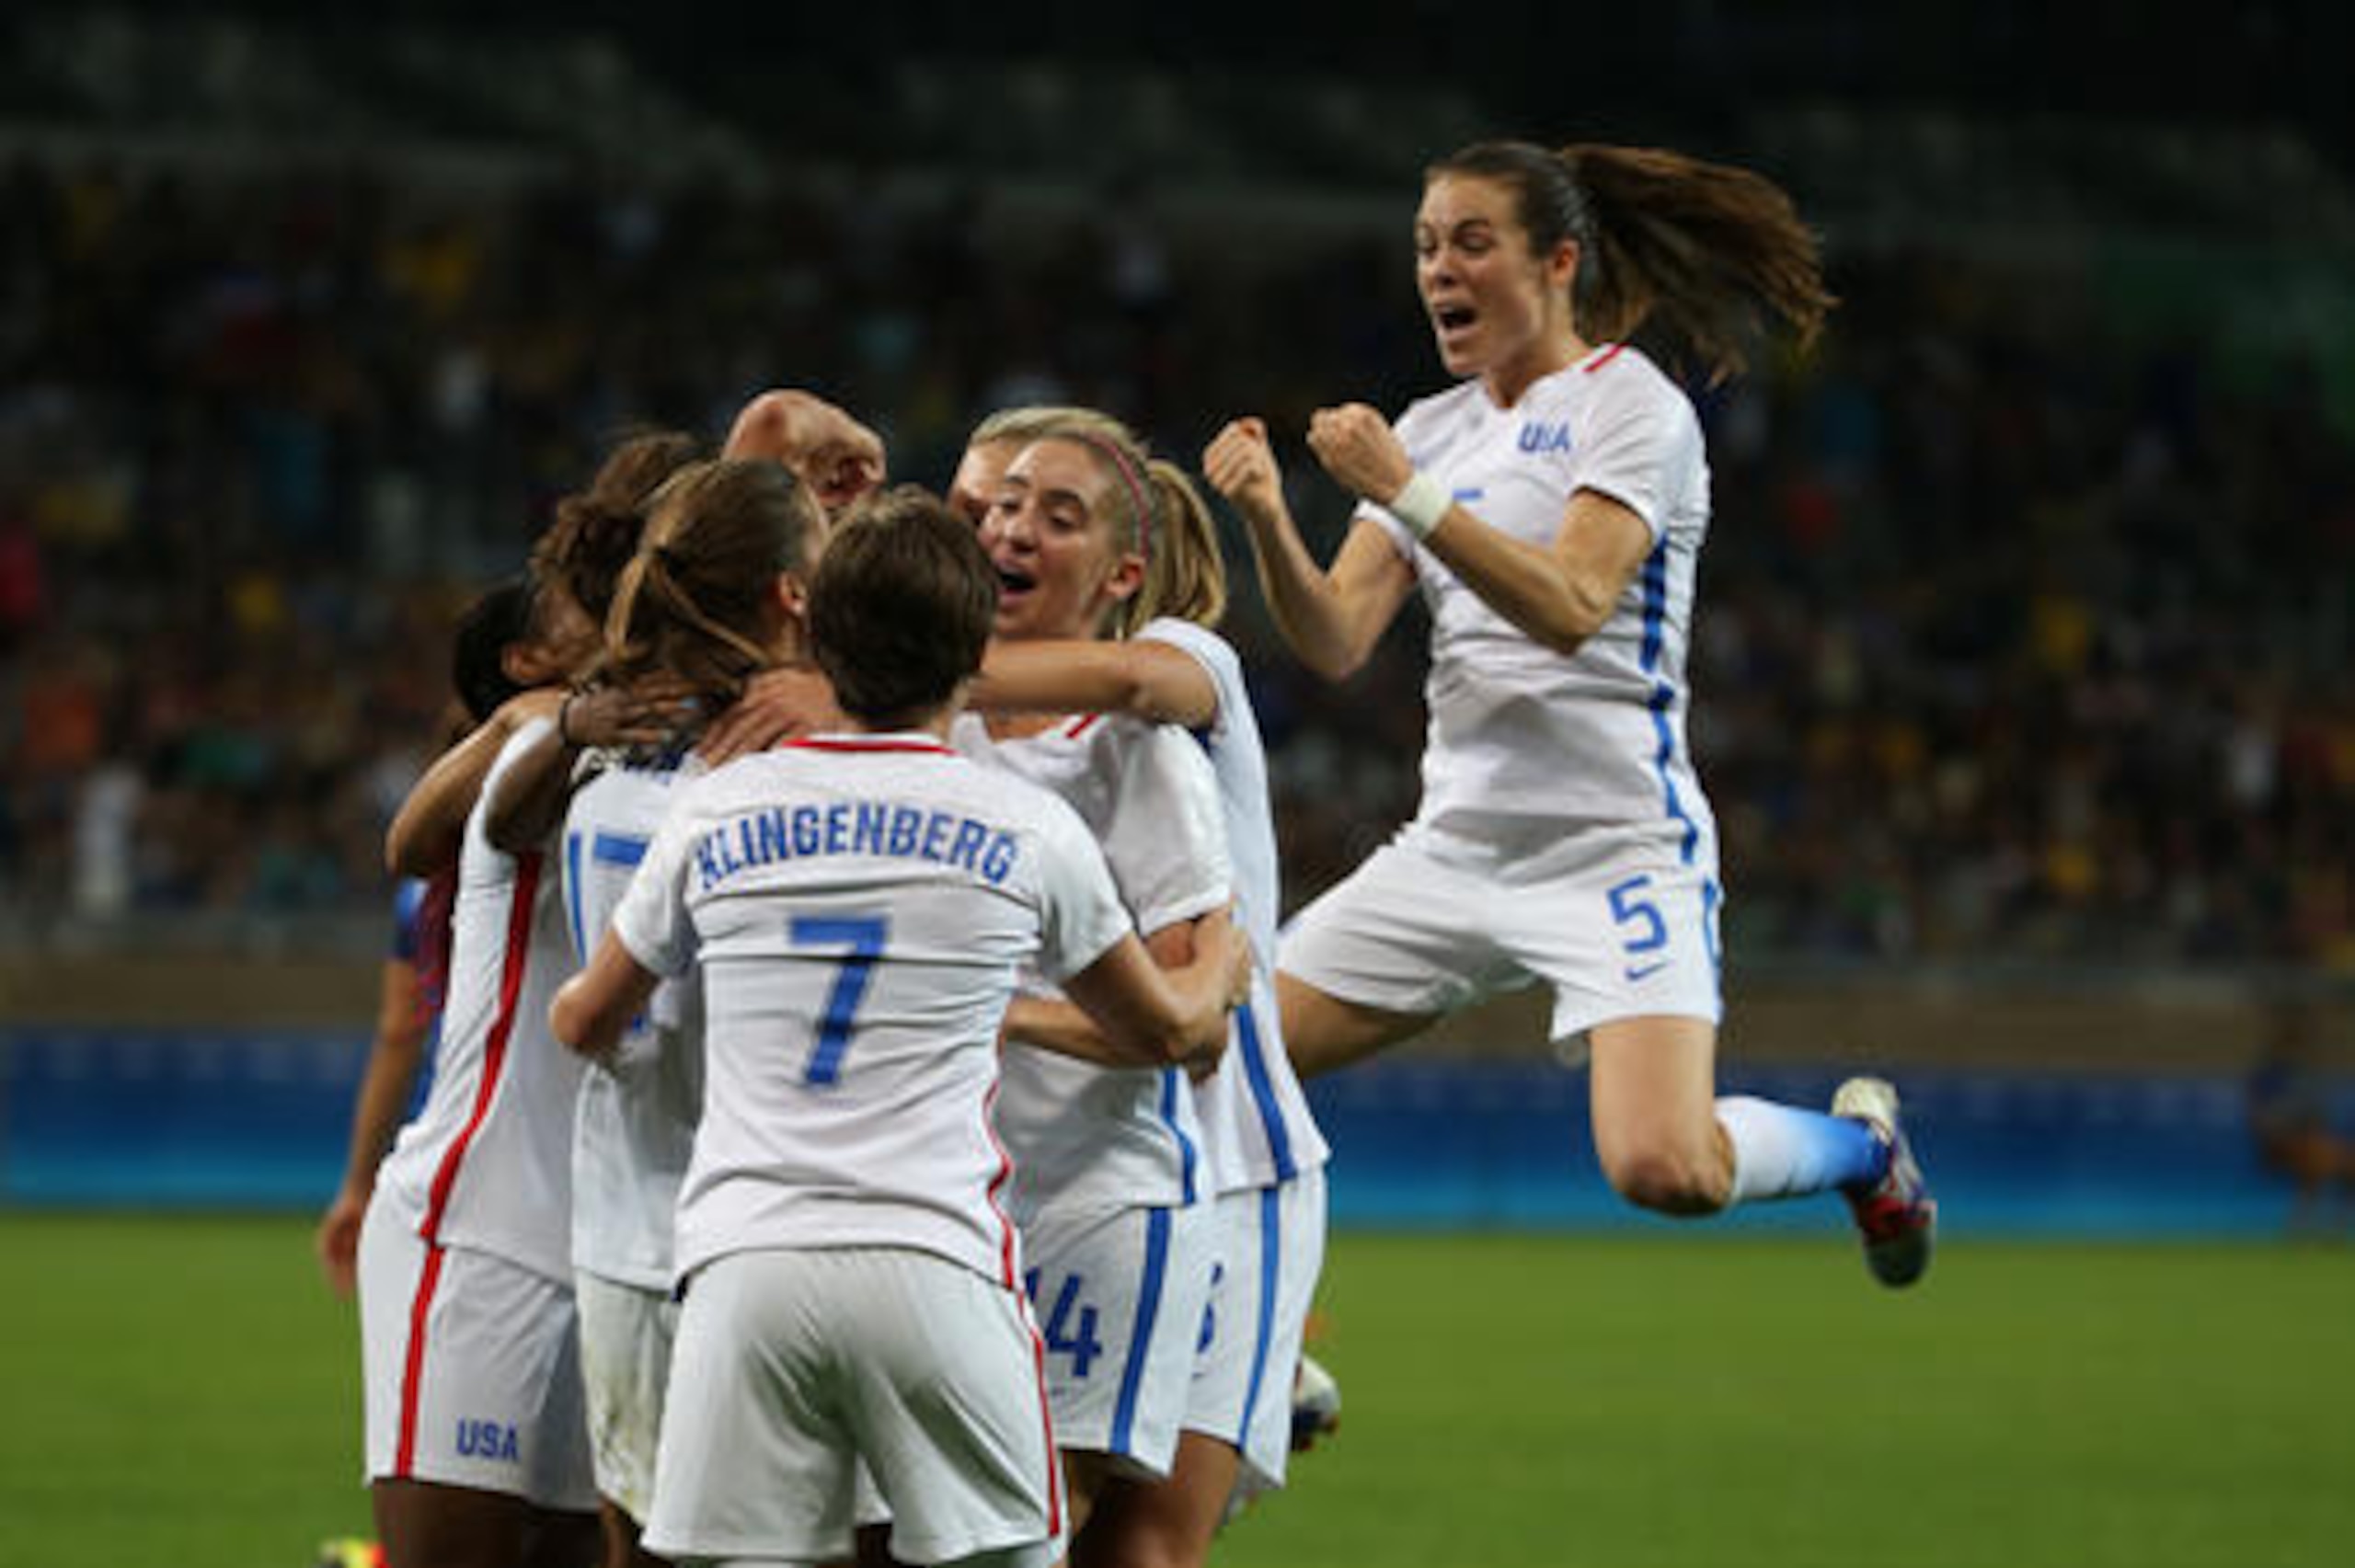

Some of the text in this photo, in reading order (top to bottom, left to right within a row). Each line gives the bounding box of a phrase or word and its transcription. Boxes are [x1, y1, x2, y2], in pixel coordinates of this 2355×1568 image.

[696, 804, 1018, 889] KLINGENBERG
[1607, 875, 1668, 954] 5
[788, 914, 888, 1085] 7
[457, 1419, 518, 1461] USA
